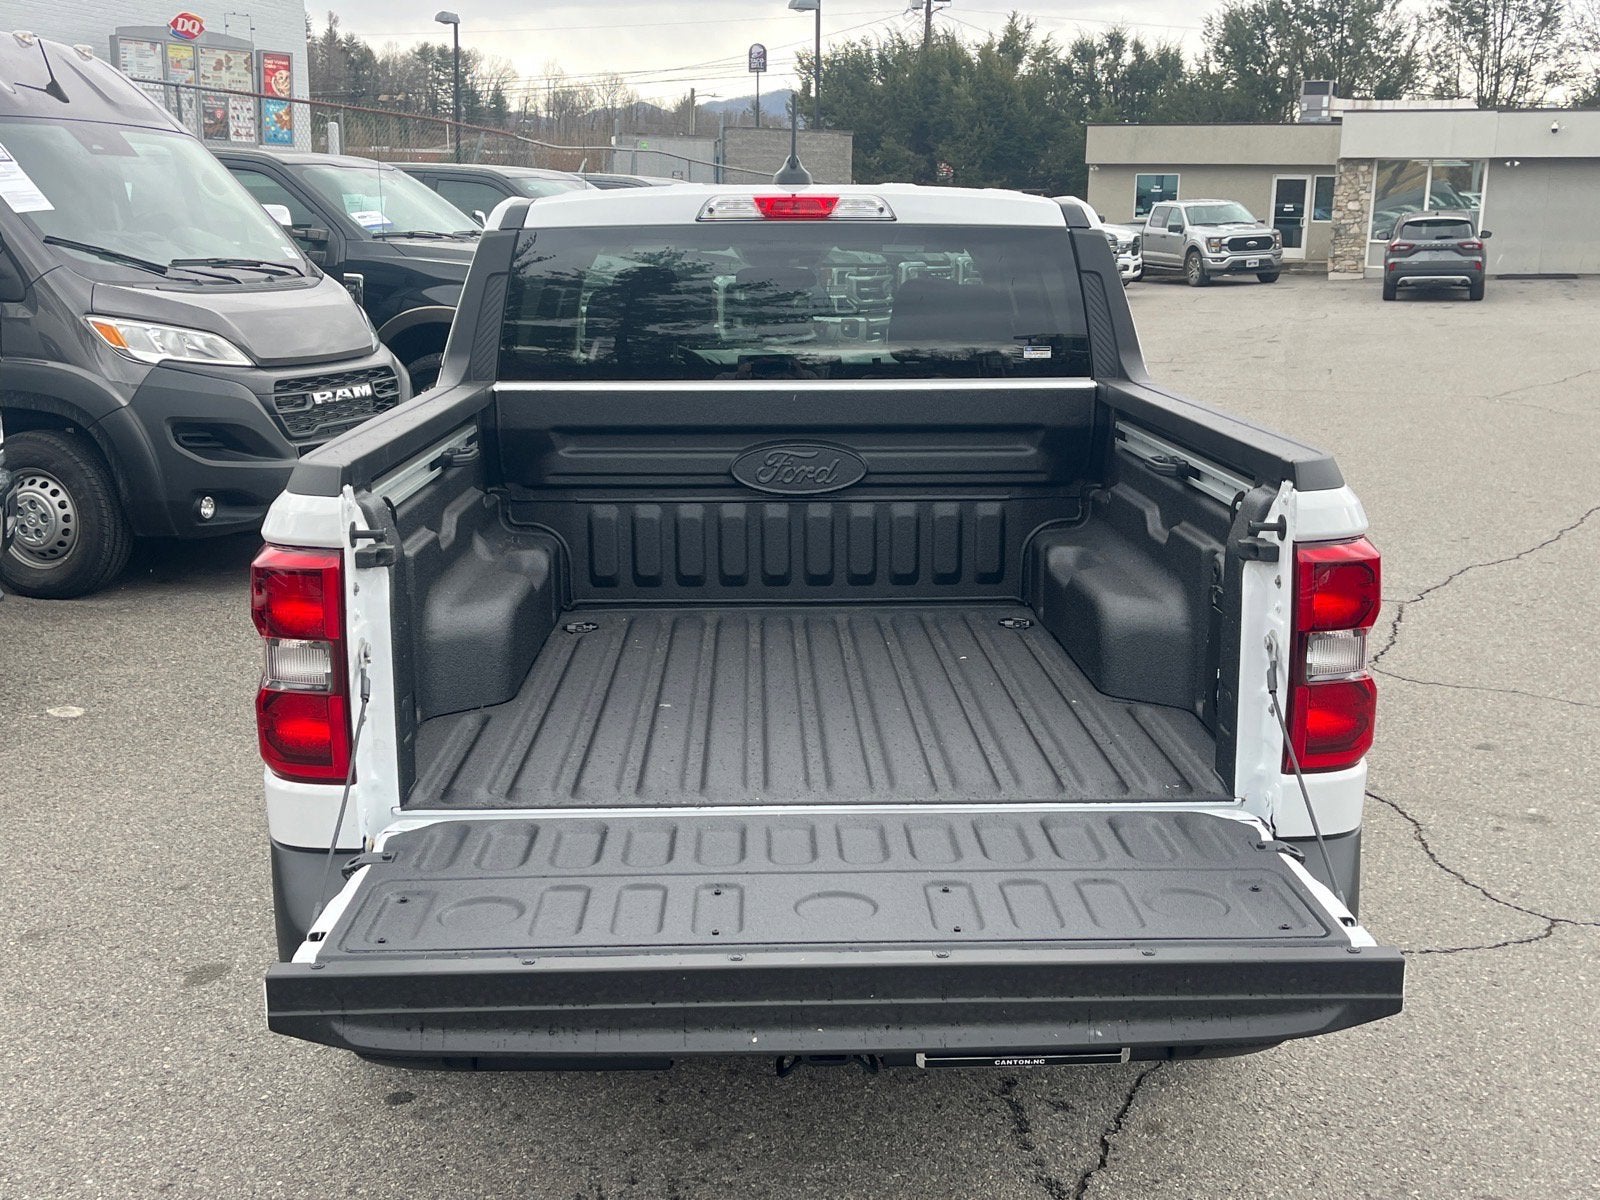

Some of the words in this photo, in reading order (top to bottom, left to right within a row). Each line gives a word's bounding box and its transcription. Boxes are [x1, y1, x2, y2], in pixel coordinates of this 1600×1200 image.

[176, 17, 200, 35] DQ
[312, 384, 372, 404] RAM
[755, 449, 840, 484] Ford
